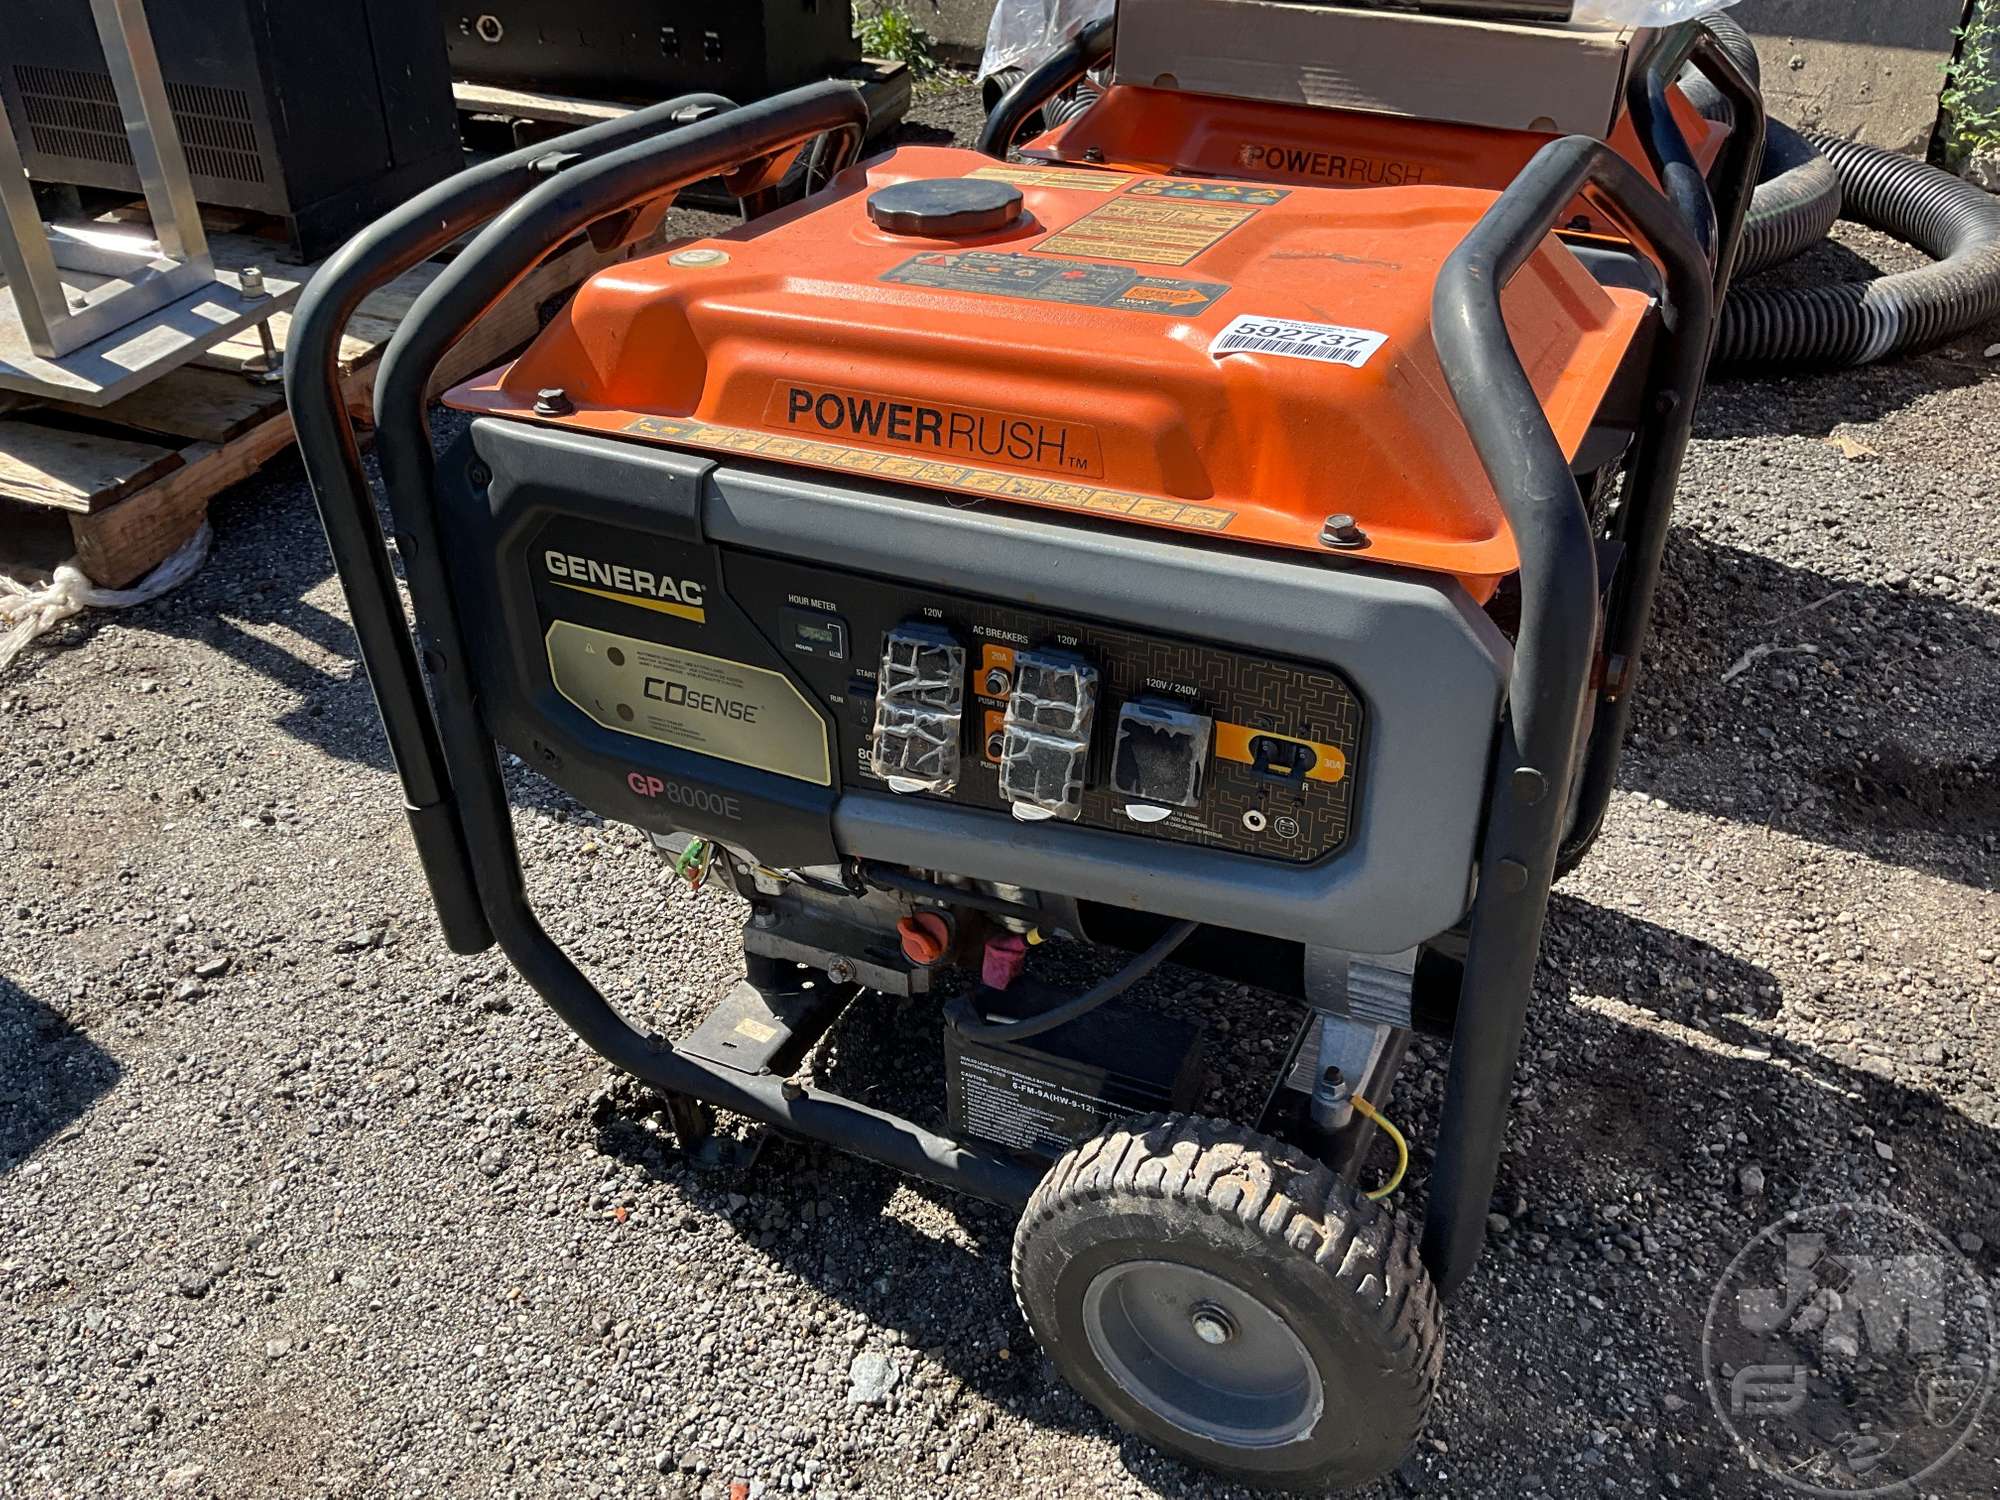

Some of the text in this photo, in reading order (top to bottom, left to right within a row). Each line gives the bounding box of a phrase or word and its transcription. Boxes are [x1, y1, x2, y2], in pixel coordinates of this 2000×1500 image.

[1249, 144, 1425, 187] POWERRUSH
[1142, 276, 1181, 286] POINT
[1116, 297, 1154, 305] AWAY
[1234, 322, 1370, 348] 592737
[787, 386, 1067, 466] POWERRUSH
[545, 550, 703, 606] GENERAC
[788, 594, 837, 611] HOUR METER
[923, 607, 943, 619] 120V
[972, 625, 1029, 645] AC BREAKERS
[1057, 634, 1078, 647] 120V
[855, 668, 877, 679] START
[1146, 677, 1167, 690] 120V
[1174, 683, 1199, 697] 240V
[829, 694, 844, 703] RUN
[978, 696, 995, 705] PUSH
[980, 761, 997, 769] PUSH
